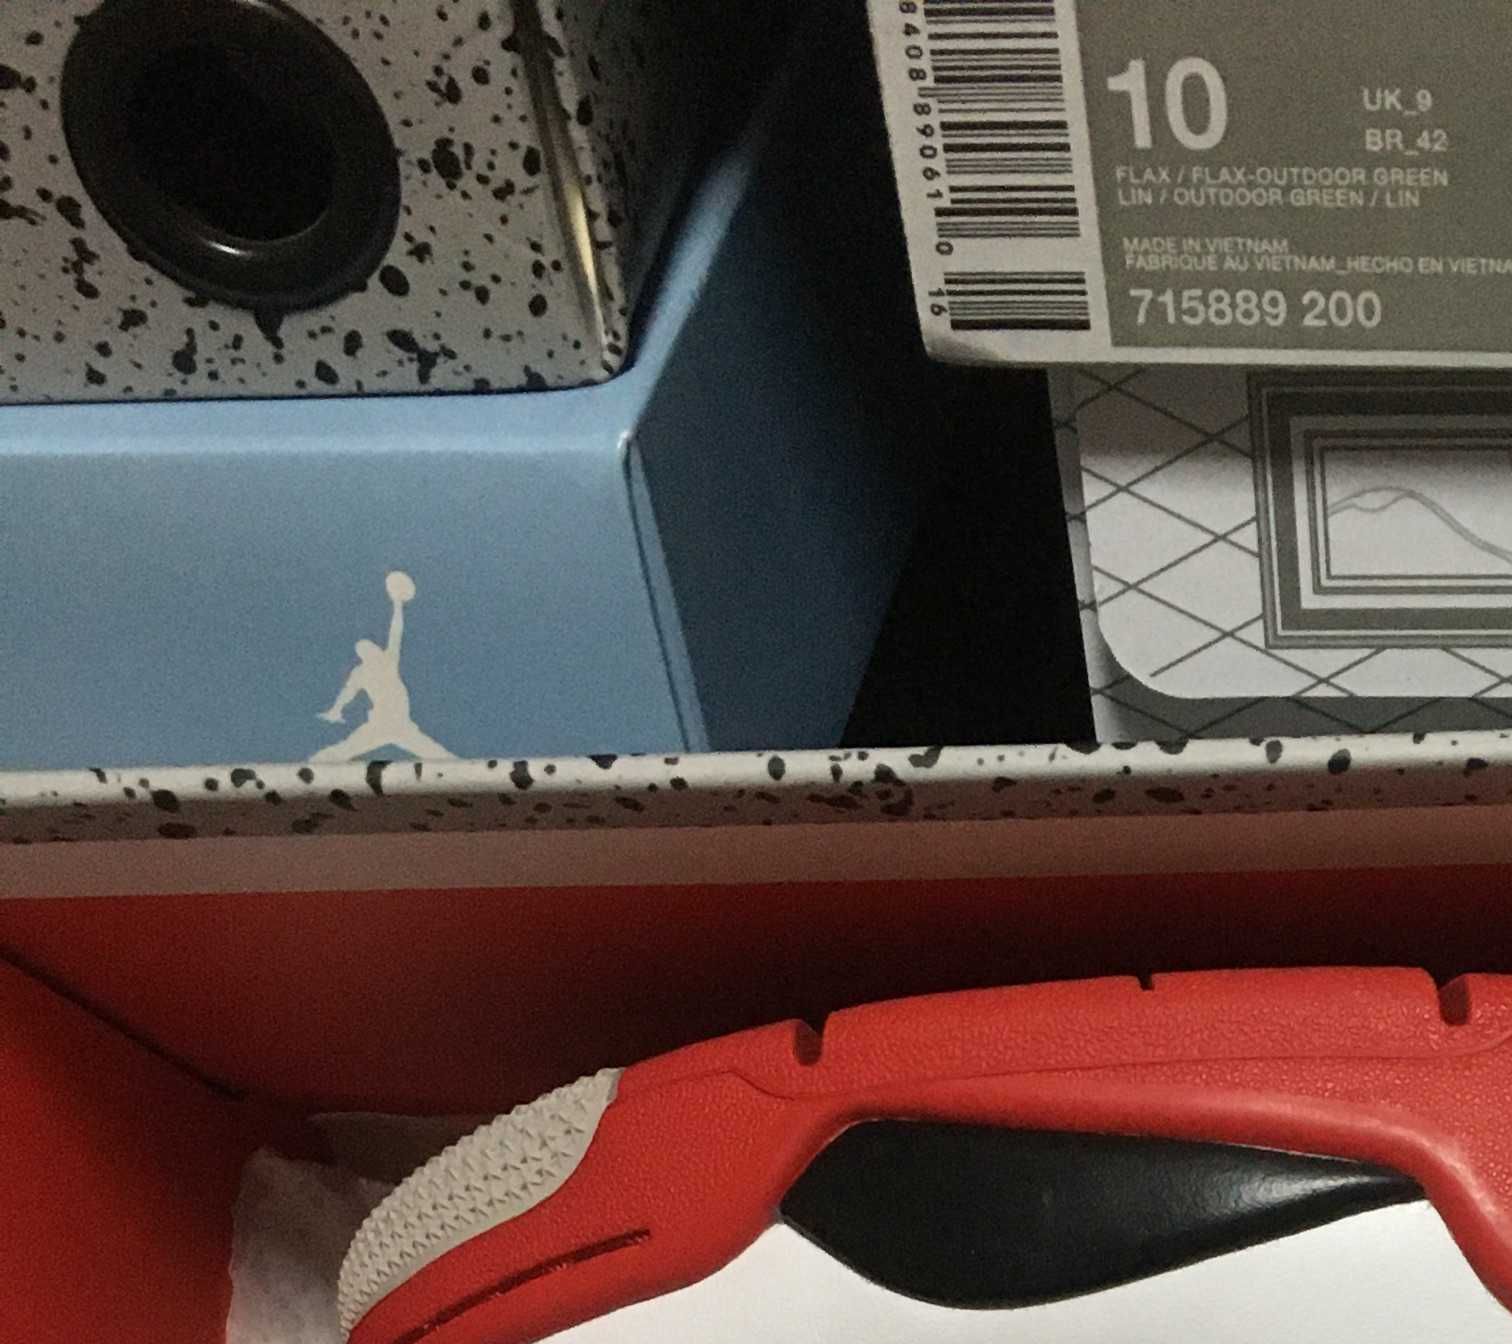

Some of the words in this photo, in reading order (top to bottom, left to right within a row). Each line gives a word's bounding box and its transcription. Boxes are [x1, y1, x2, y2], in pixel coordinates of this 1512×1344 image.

[1107, 56, 1228, 150] 10
[1363, 87, 1432, 116] UK_9
[913, 103, 945, 199] 89061
[1365, 128, 1449, 156] BR_42
[1115, 166, 1171, 184] FLAX
[1192, 167, 1366, 186] FLAX-OUTDOOR
[1374, 167, 1449, 187] GREEN
[1118, 187, 1152, 206] LIN
[1173, 188, 1283, 207] OUTDOOR
[1290, 188, 1364, 207] GREEN
[1386, 190, 1420, 208] LIN
[1123, 237, 1176, 253] MADE
[1182, 238, 1202, 253] IN
[1205, 238, 1289, 254] VIETNAM
[1125, 255, 1218, 271] FABRIQUE
[1223, 256, 1249, 272] AU
[1418, 256, 1444, 274] EN
[1129, 288, 1287, 327] 715889
[1302, 290, 1382, 328] 200
